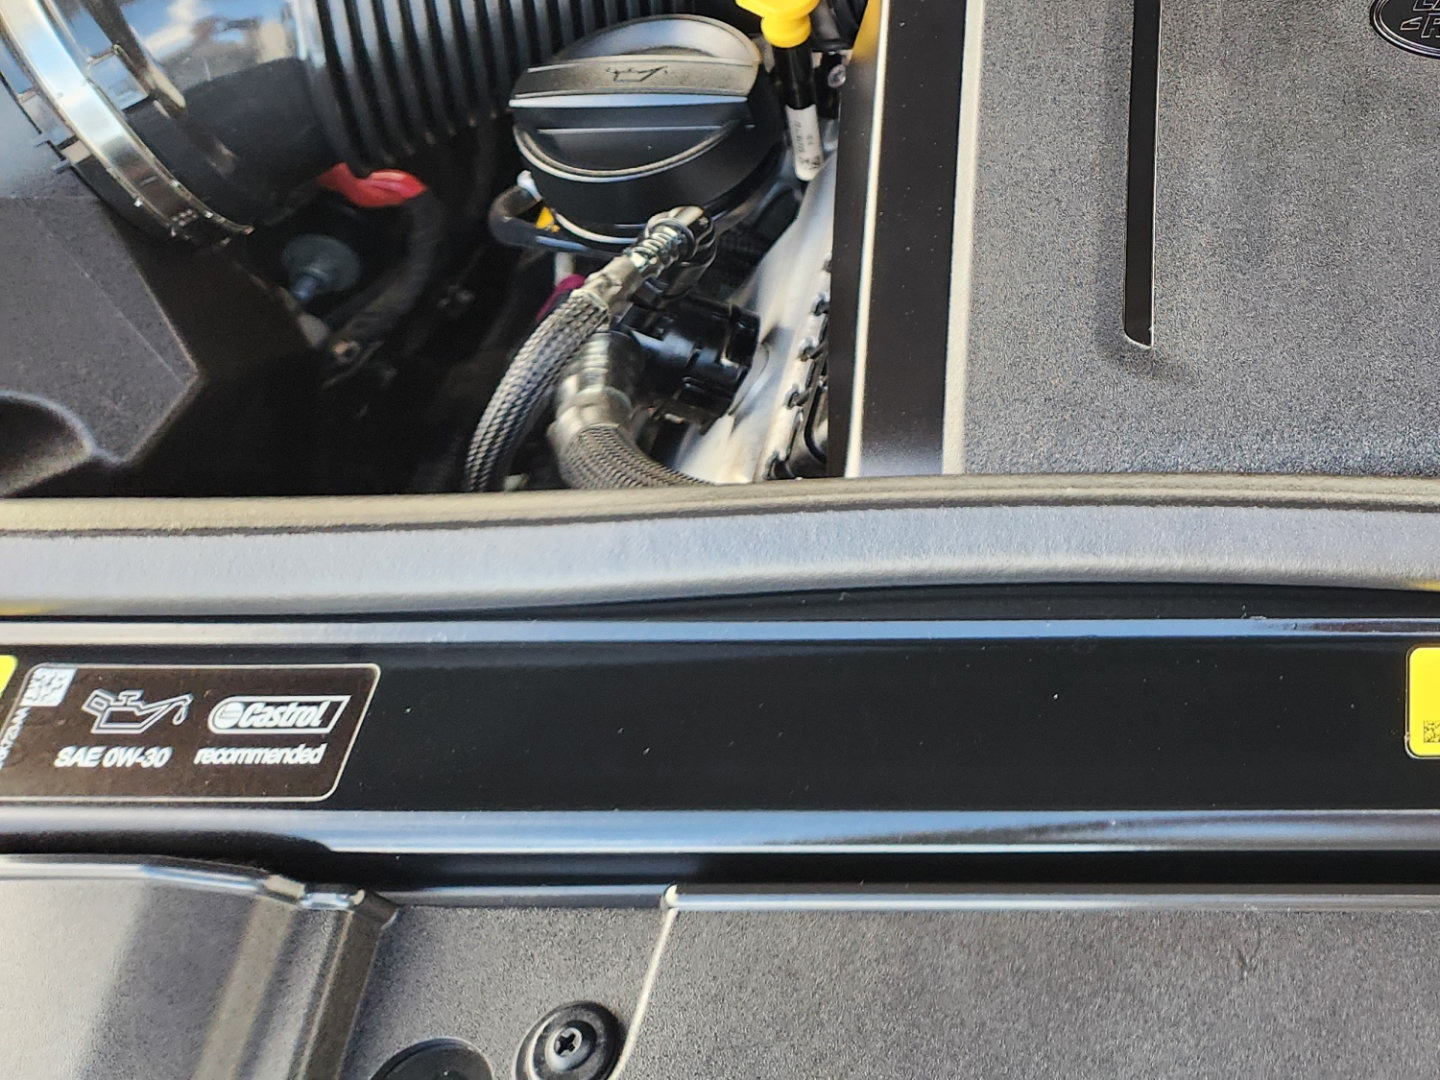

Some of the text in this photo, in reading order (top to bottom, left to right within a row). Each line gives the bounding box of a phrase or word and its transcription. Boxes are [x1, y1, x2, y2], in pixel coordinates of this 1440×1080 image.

[237, 700, 331, 728] Castrol
[54, 745, 173, 768] SAE 0W-30
[193, 743, 328, 766] recommended
